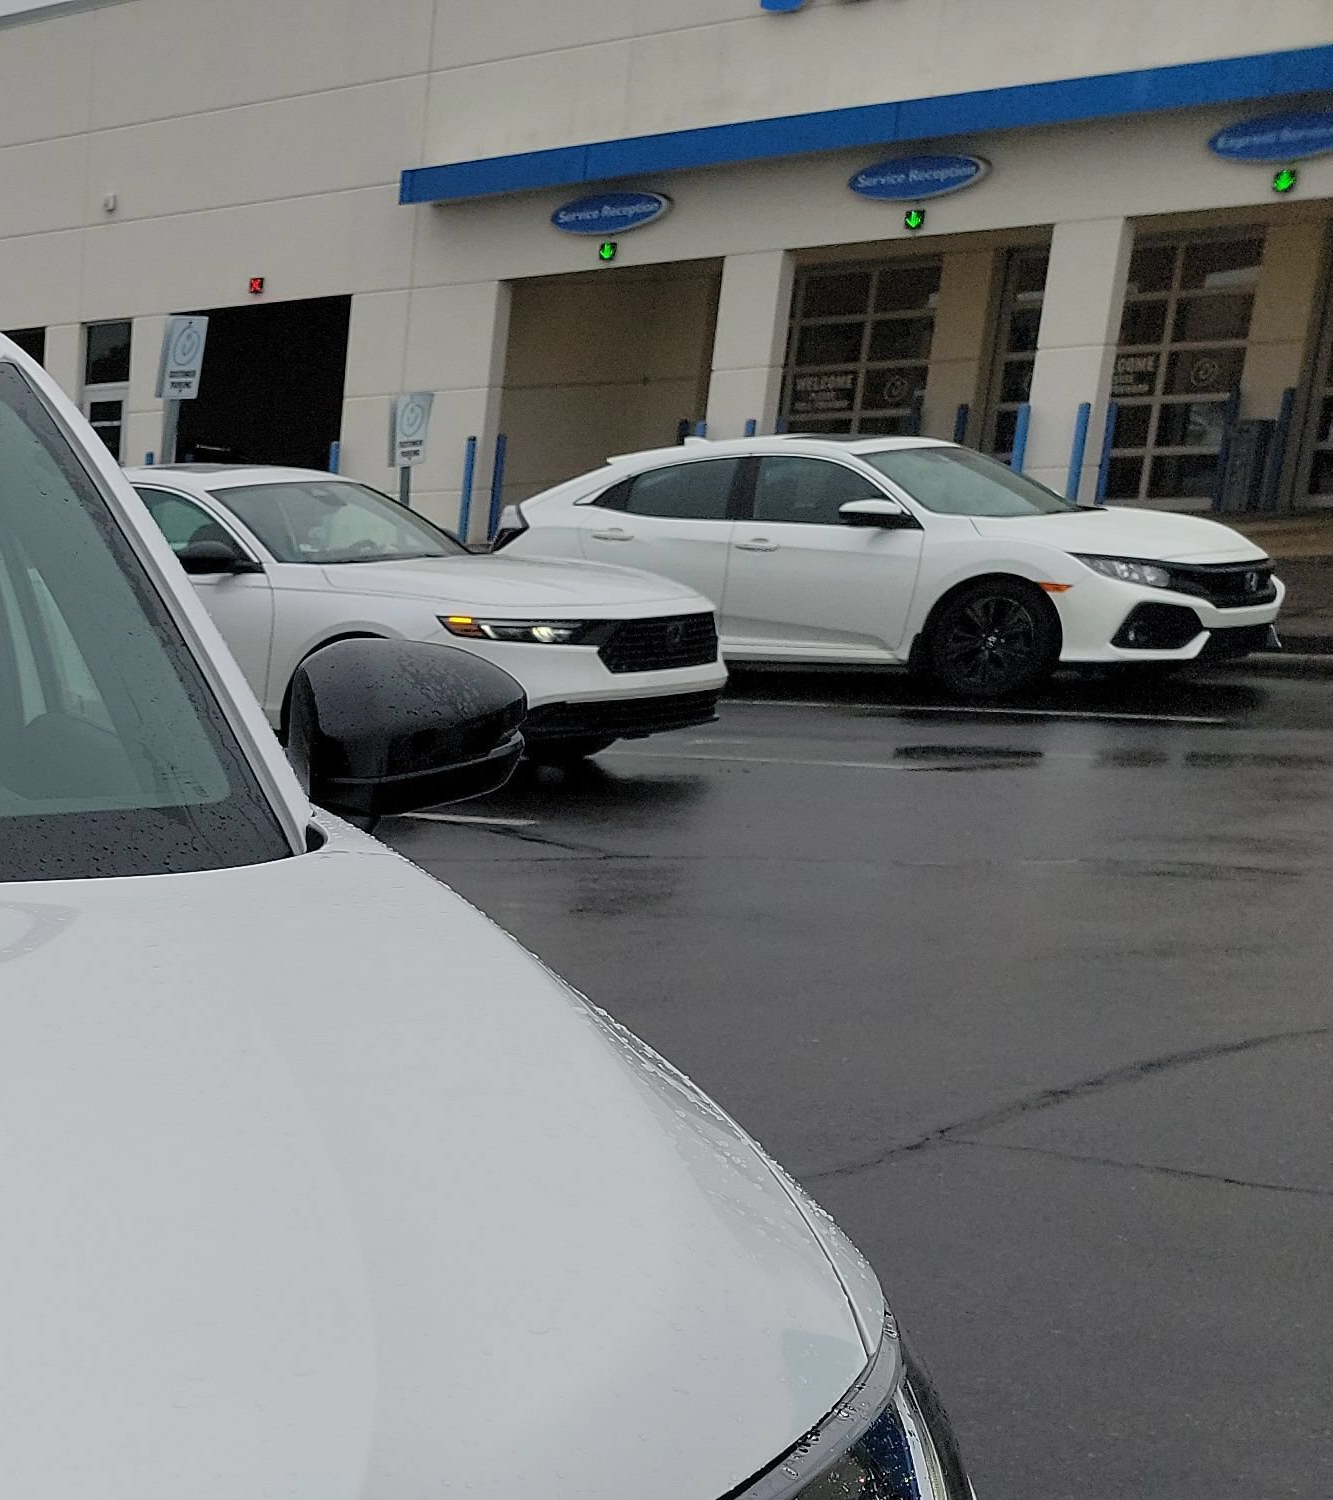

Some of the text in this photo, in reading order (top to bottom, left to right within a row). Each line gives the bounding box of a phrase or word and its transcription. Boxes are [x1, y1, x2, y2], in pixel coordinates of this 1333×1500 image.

[857, 164, 977, 188] Service Reception
[558, 202, 660, 223] Service Reception
